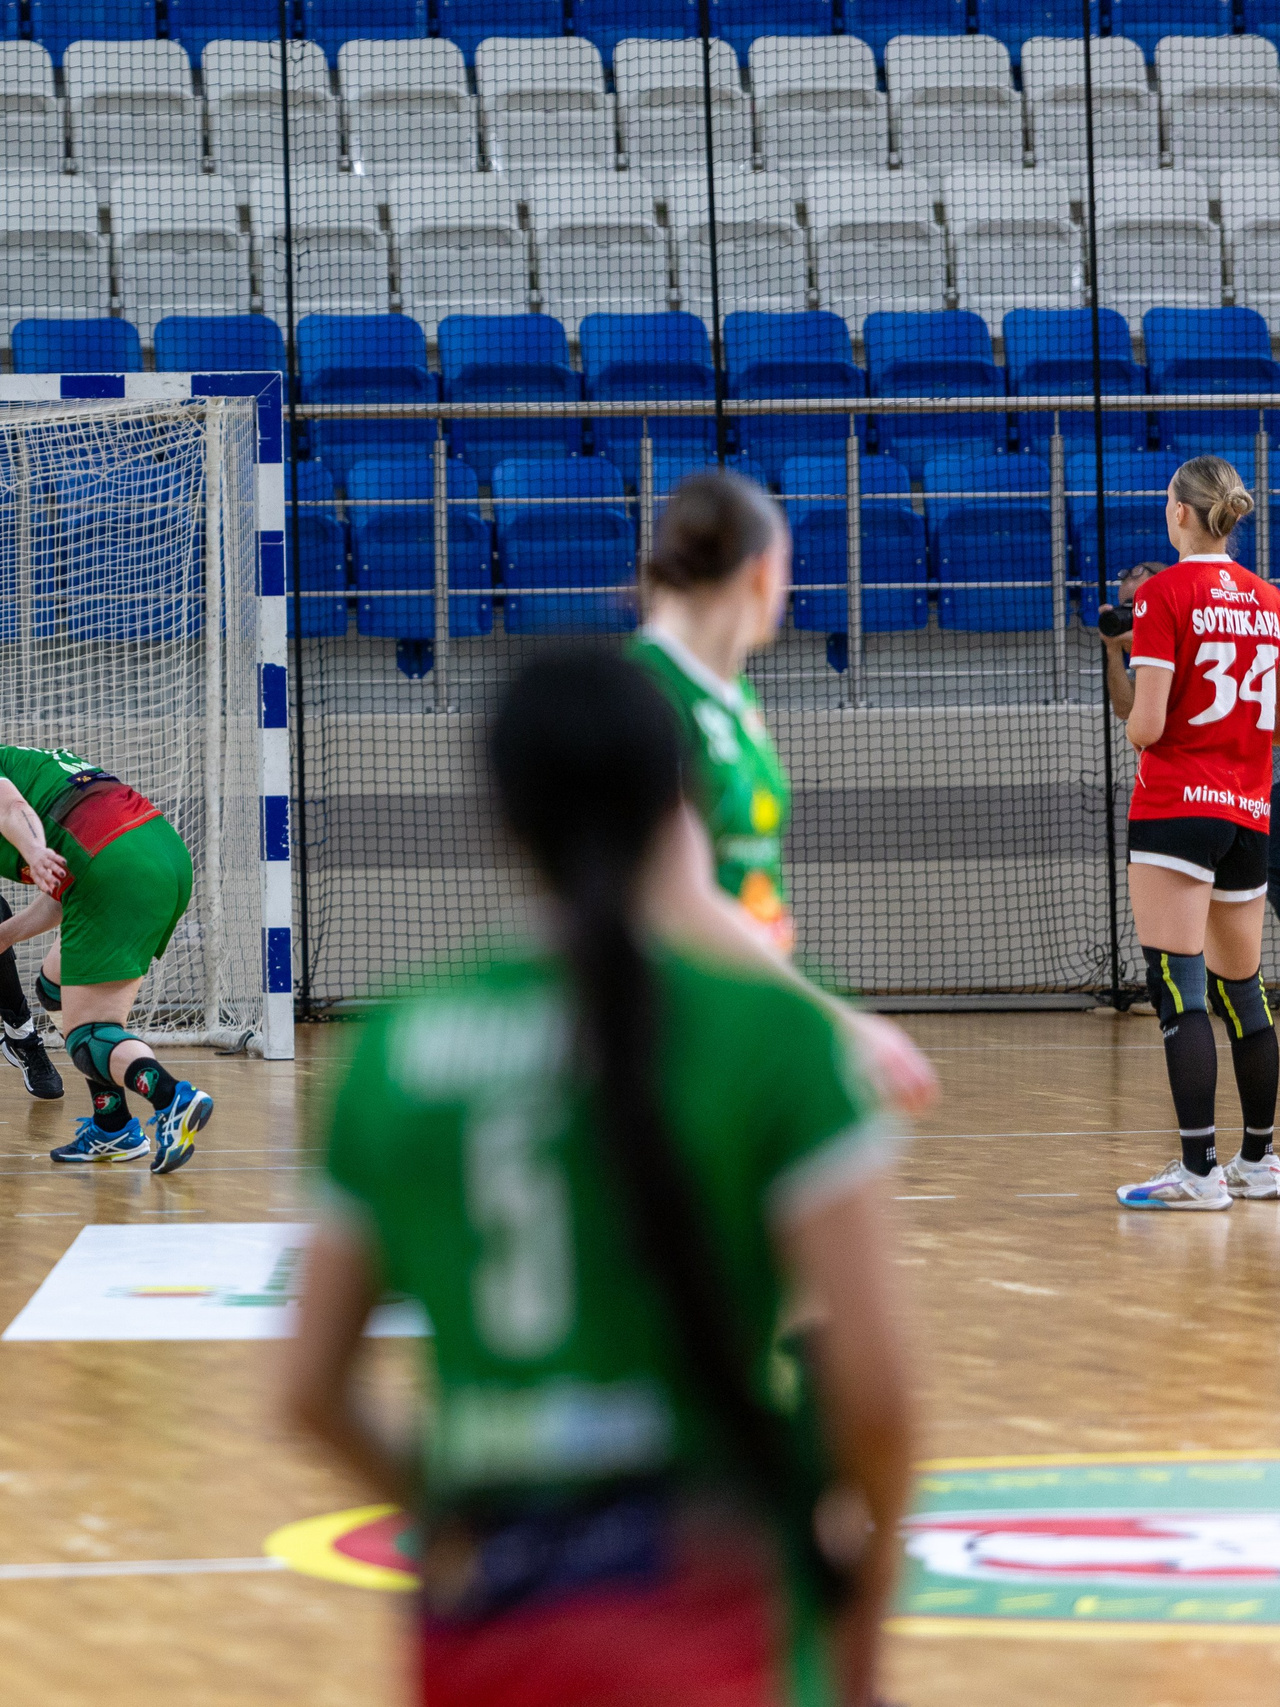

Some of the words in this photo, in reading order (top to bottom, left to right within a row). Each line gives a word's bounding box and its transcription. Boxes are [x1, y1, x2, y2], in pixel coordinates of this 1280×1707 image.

[1210, 588, 1260, 606] SPORTIX
[1192, 606, 1280, 639] SOTNIKAVA
[1188, 642, 1279, 731] 34
[1183, 785, 1235, 807] Minsk
